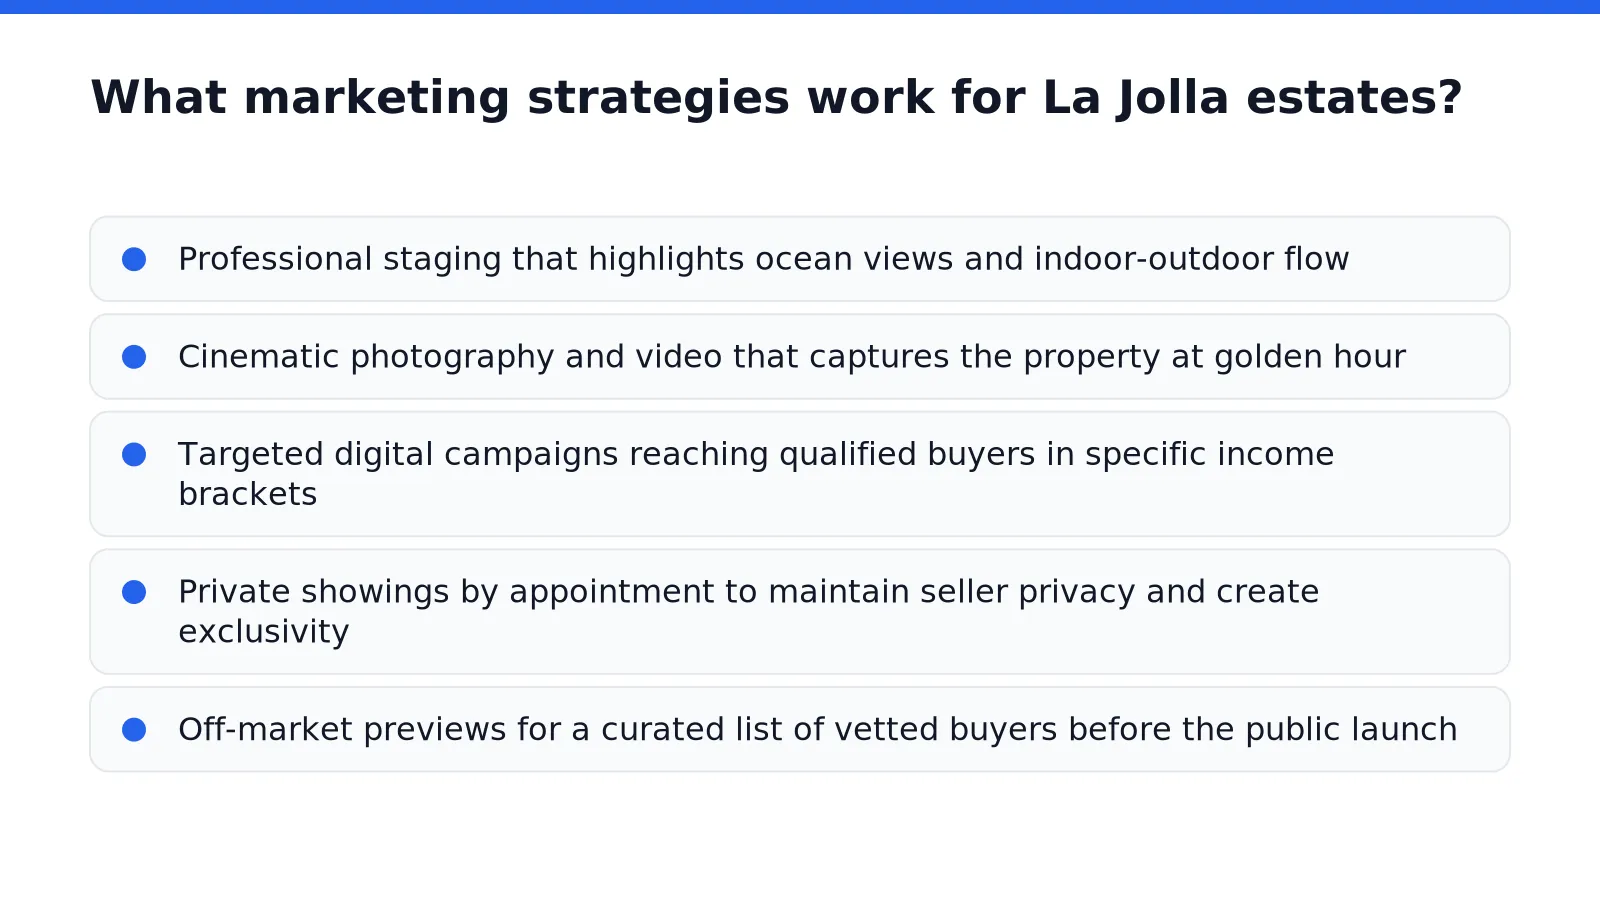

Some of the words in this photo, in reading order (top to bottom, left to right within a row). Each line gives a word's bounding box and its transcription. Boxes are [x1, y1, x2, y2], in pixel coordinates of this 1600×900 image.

[92, 78, 226, 114] What
[247, 78, 507, 123] marketing
[529, 78, 788, 123] strategies
[808, 78, 935, 114] work
[952, 78, 1026, 114] for
[1046, 79, 1099, 114] La
[1115, 78, 1227, 122] Jolla
[1248, 79, 1461, 114] estates?
[181, 246, 370, 270] Professional
[385, 246, 500, 277] staging
[513, 246, 577, 270] that
[591, 246, 743, 277] highlights
[757, 252, 851, 270] ocean
[864, 246, 952, 270] views
[966, 246, 1022, 270] and
[1037, 246, 1274, 270] indoor-outdoor
[1285, 246, 1349, 270] flow
[180, 343, 338, 368] Cinematic
[353, 343, 554, 375] photography
[567, 343, 623, 368] and
[636, 343, 721, 368] video
[734, 343, 798, 368] that
[811, 345, 948, 375] captures
[961, 343, 1011, 368] the
[1026, 345, 1160, 375] property
[1173, 345, 1203, 368] at
[1216, 343, 1321, 375] golden
[1336, 343, 1406, 368] hour
[178, 441, 322, 472] Targeted
[336, 441, 431, 472] digital
[446, 441, 617, 472] campaigns
[632, 441, 767, 472] reaching
[781, 441, 915, 472] qualified
[930, 441, 1034, 472] buyers
[1049, 441, 1073, 465] in
[1087, 441, 1205, 472] specific
[1220, 441, 1333, 465] income
[181, 481, 316, 505] brackets
[181, 578, 289, 603] Private
[303, 578, 448, 610] showings
[463, 578, 498, 610] by
[511, 578, 714, 610] appointment
[726, 580, 756, 603] to
[771, 578, 908, 603] maintain
[922, 578, 1008, 603] seller
[1021, 578, 1135, 610] privacy
[1148, 578, 1204, 603] and
[1218, 580, 1318, 603] create
[180, 618, 349, 650] exclusivity
[180, 716, 352, 740] Off-market
[366, 716, 505, 747] previews
[518, 716, 561, 740] for
[573, 722, 588, 740] a
[603, 716, 723, 740] curated
[738, 716, 782, 740] list
[795, 716, 825, 740] of
[835, 716, 937, 740] vetted
[952, 716, 1056, 747] buyers
[1071, 716, 1170, 740] before
[1183, 716, 1233, 740] the
[1248, 716, 1339, 747] public
[1354, 716, 1456, 740] launch
